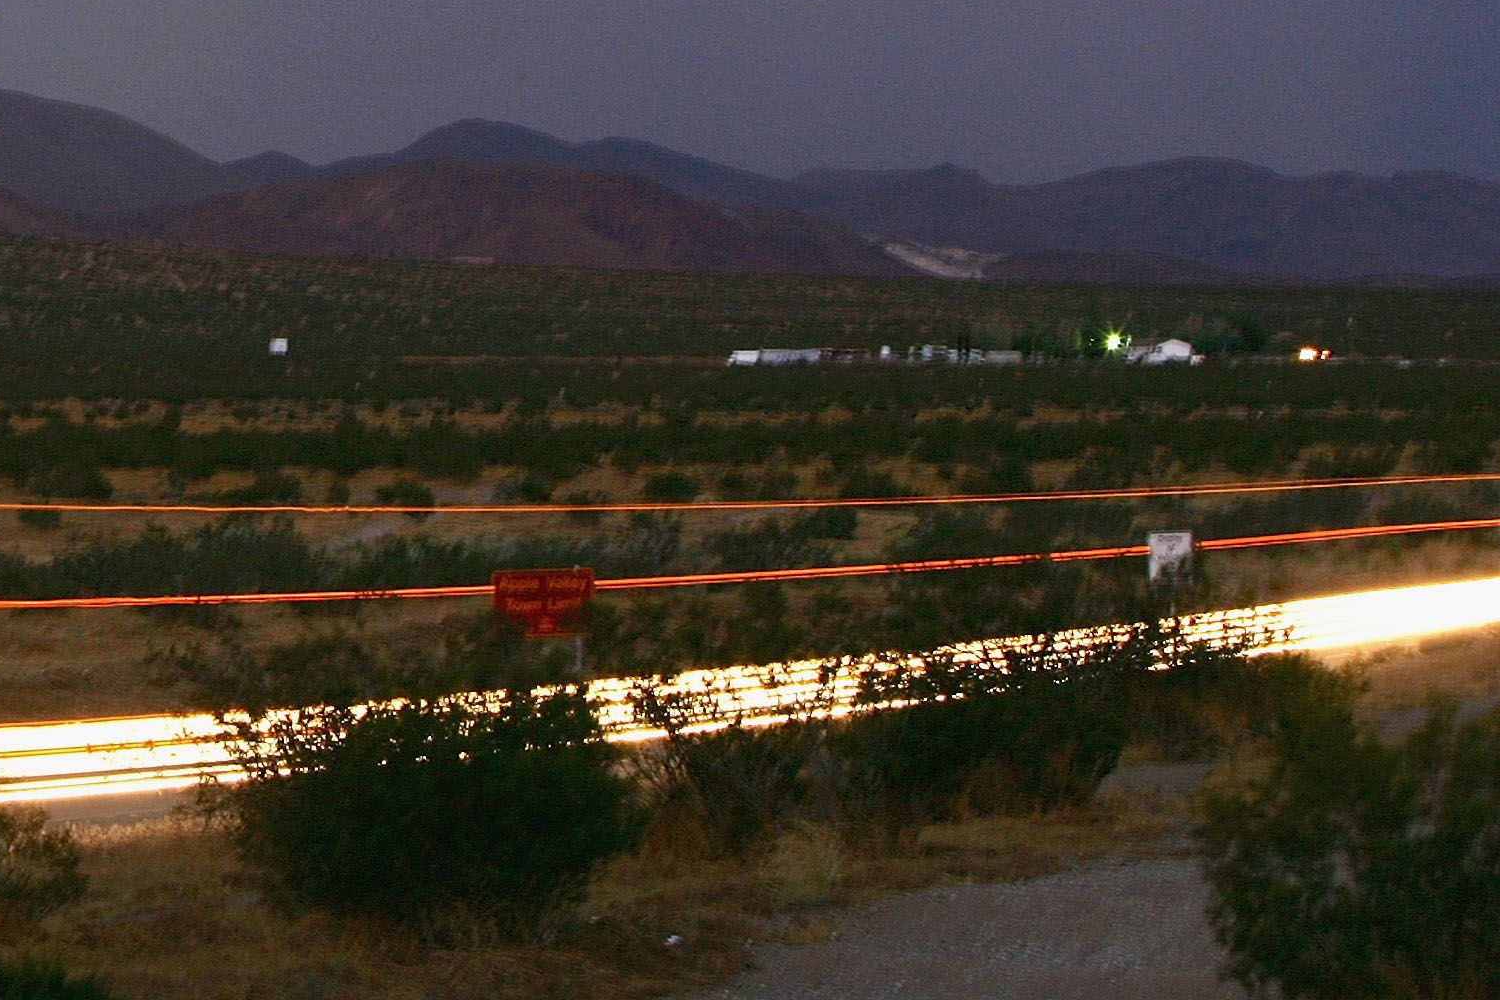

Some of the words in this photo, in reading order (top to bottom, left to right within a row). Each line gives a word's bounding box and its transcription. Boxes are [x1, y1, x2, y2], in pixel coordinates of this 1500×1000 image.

[499, 577, 539, 592] Apple
[547, 576, 587, 592] Valley
[506, 597, 542, 610] Town
